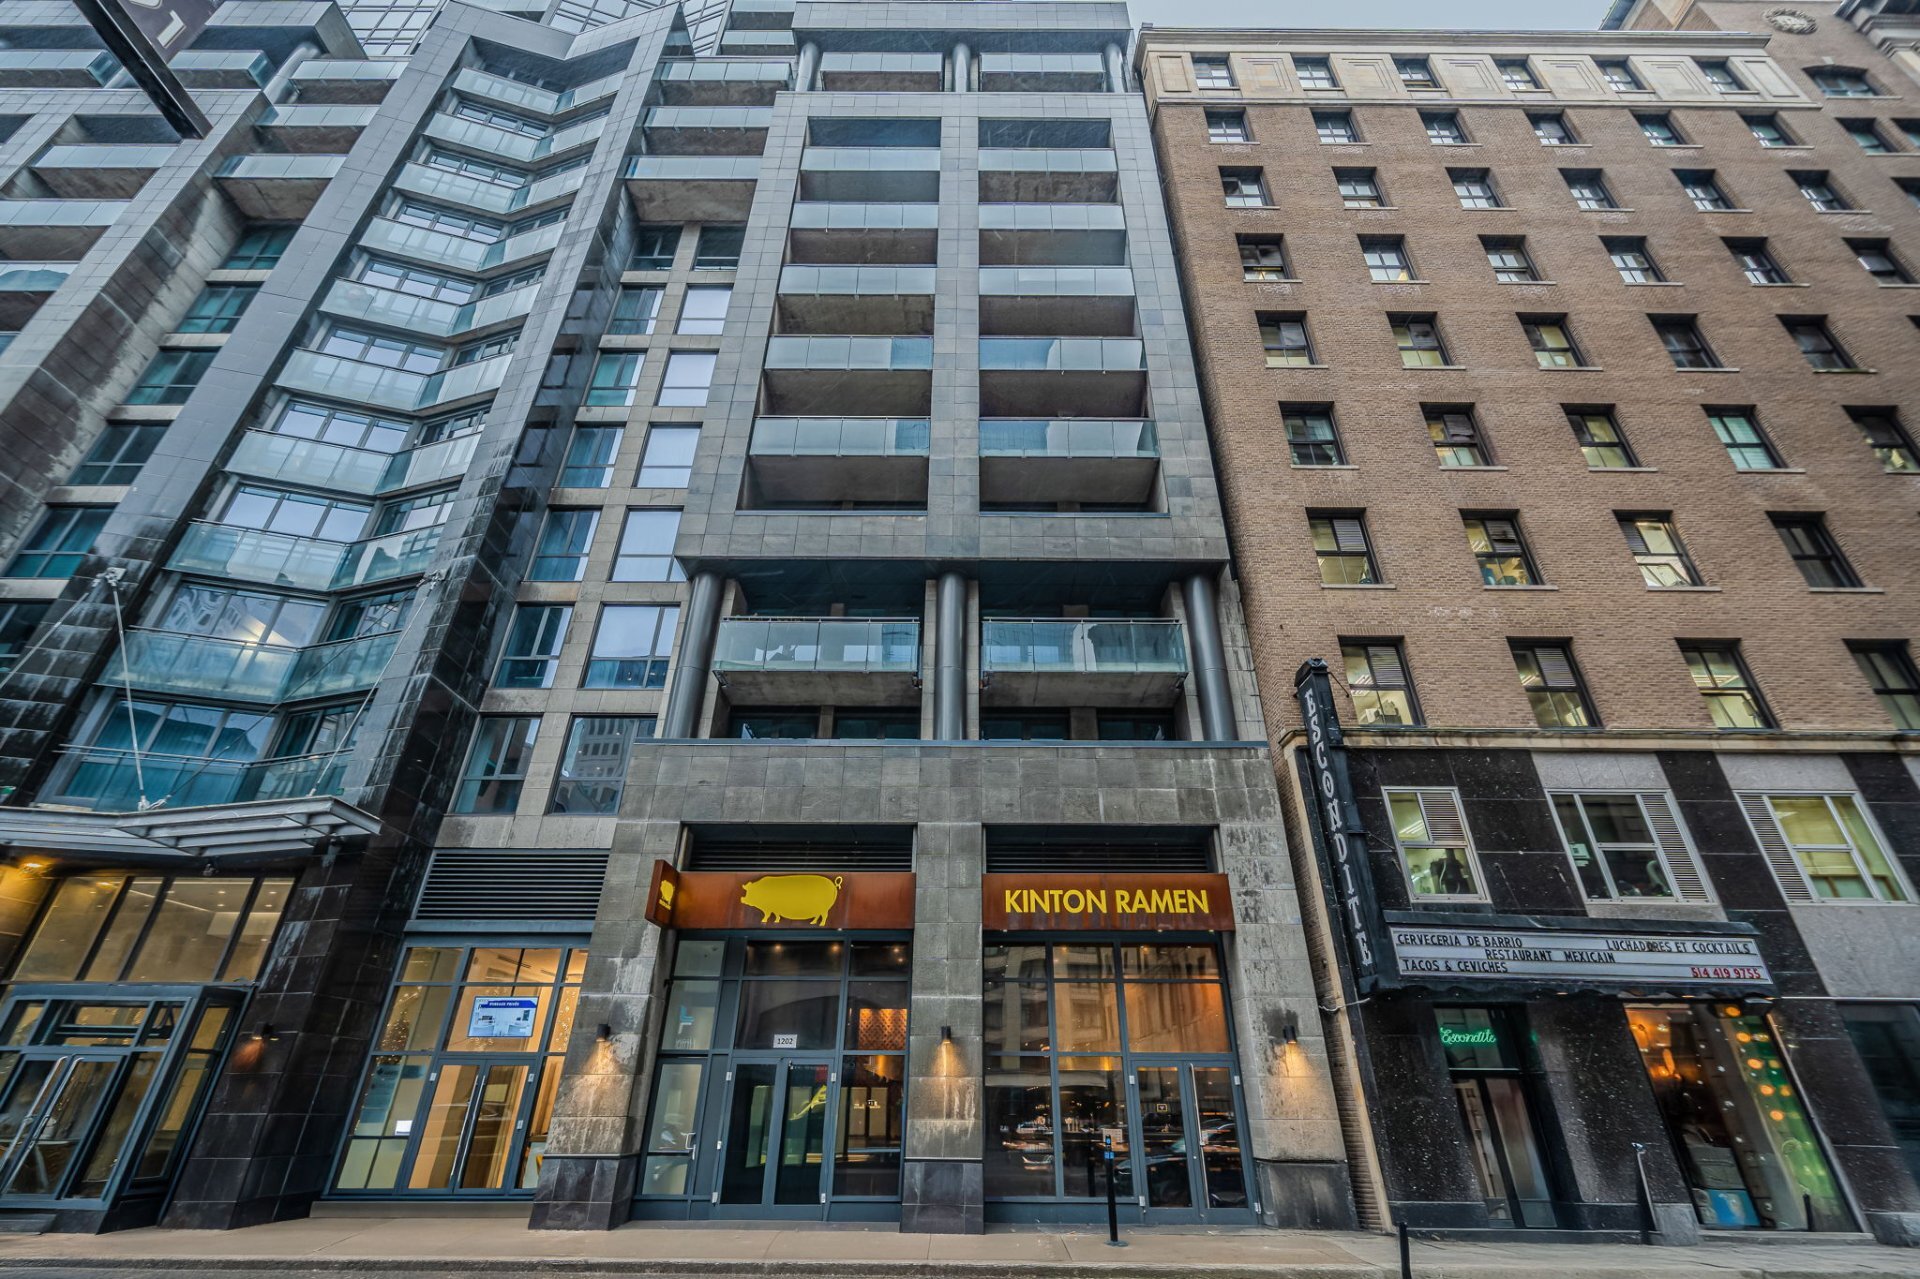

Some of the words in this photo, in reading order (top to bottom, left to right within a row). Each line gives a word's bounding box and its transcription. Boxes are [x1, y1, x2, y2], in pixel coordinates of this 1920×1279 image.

[1304, 688, 1373, 967] ESCONDITE
[1005, 889, 1107, 914] KINTON
[1115, 889, 1209, 914] RAMEN
[1397, 933, 1461, 946] CERVECERIA
[1467, 936, 1481, 947] DE
[1483, 936, 1523, 948] BARRIO
[1605, 939, 1672, 953] LUCHADORES
[1675, 941, 1688, 953] ET
[1692, 942, 1751, 955] COCKTAILS
[1484, 949, 1552, 962] RESTAURANT
[1564, 951, 1616, 963] MEXICAIN
[1402, 959, 1440, 972] TACOS
[1445, 961, 1453, 972] &
[1457, 960, 1508, 973] CEVICHES
[1690, 967, 1711, 979] 514
[1713, 967, 1731, 979] 419
[1733, 968, 1761, 979] 9755
[777, 1037, 794, 1045] 1202
[1440, 1027, 1496, 1045] Escondite
